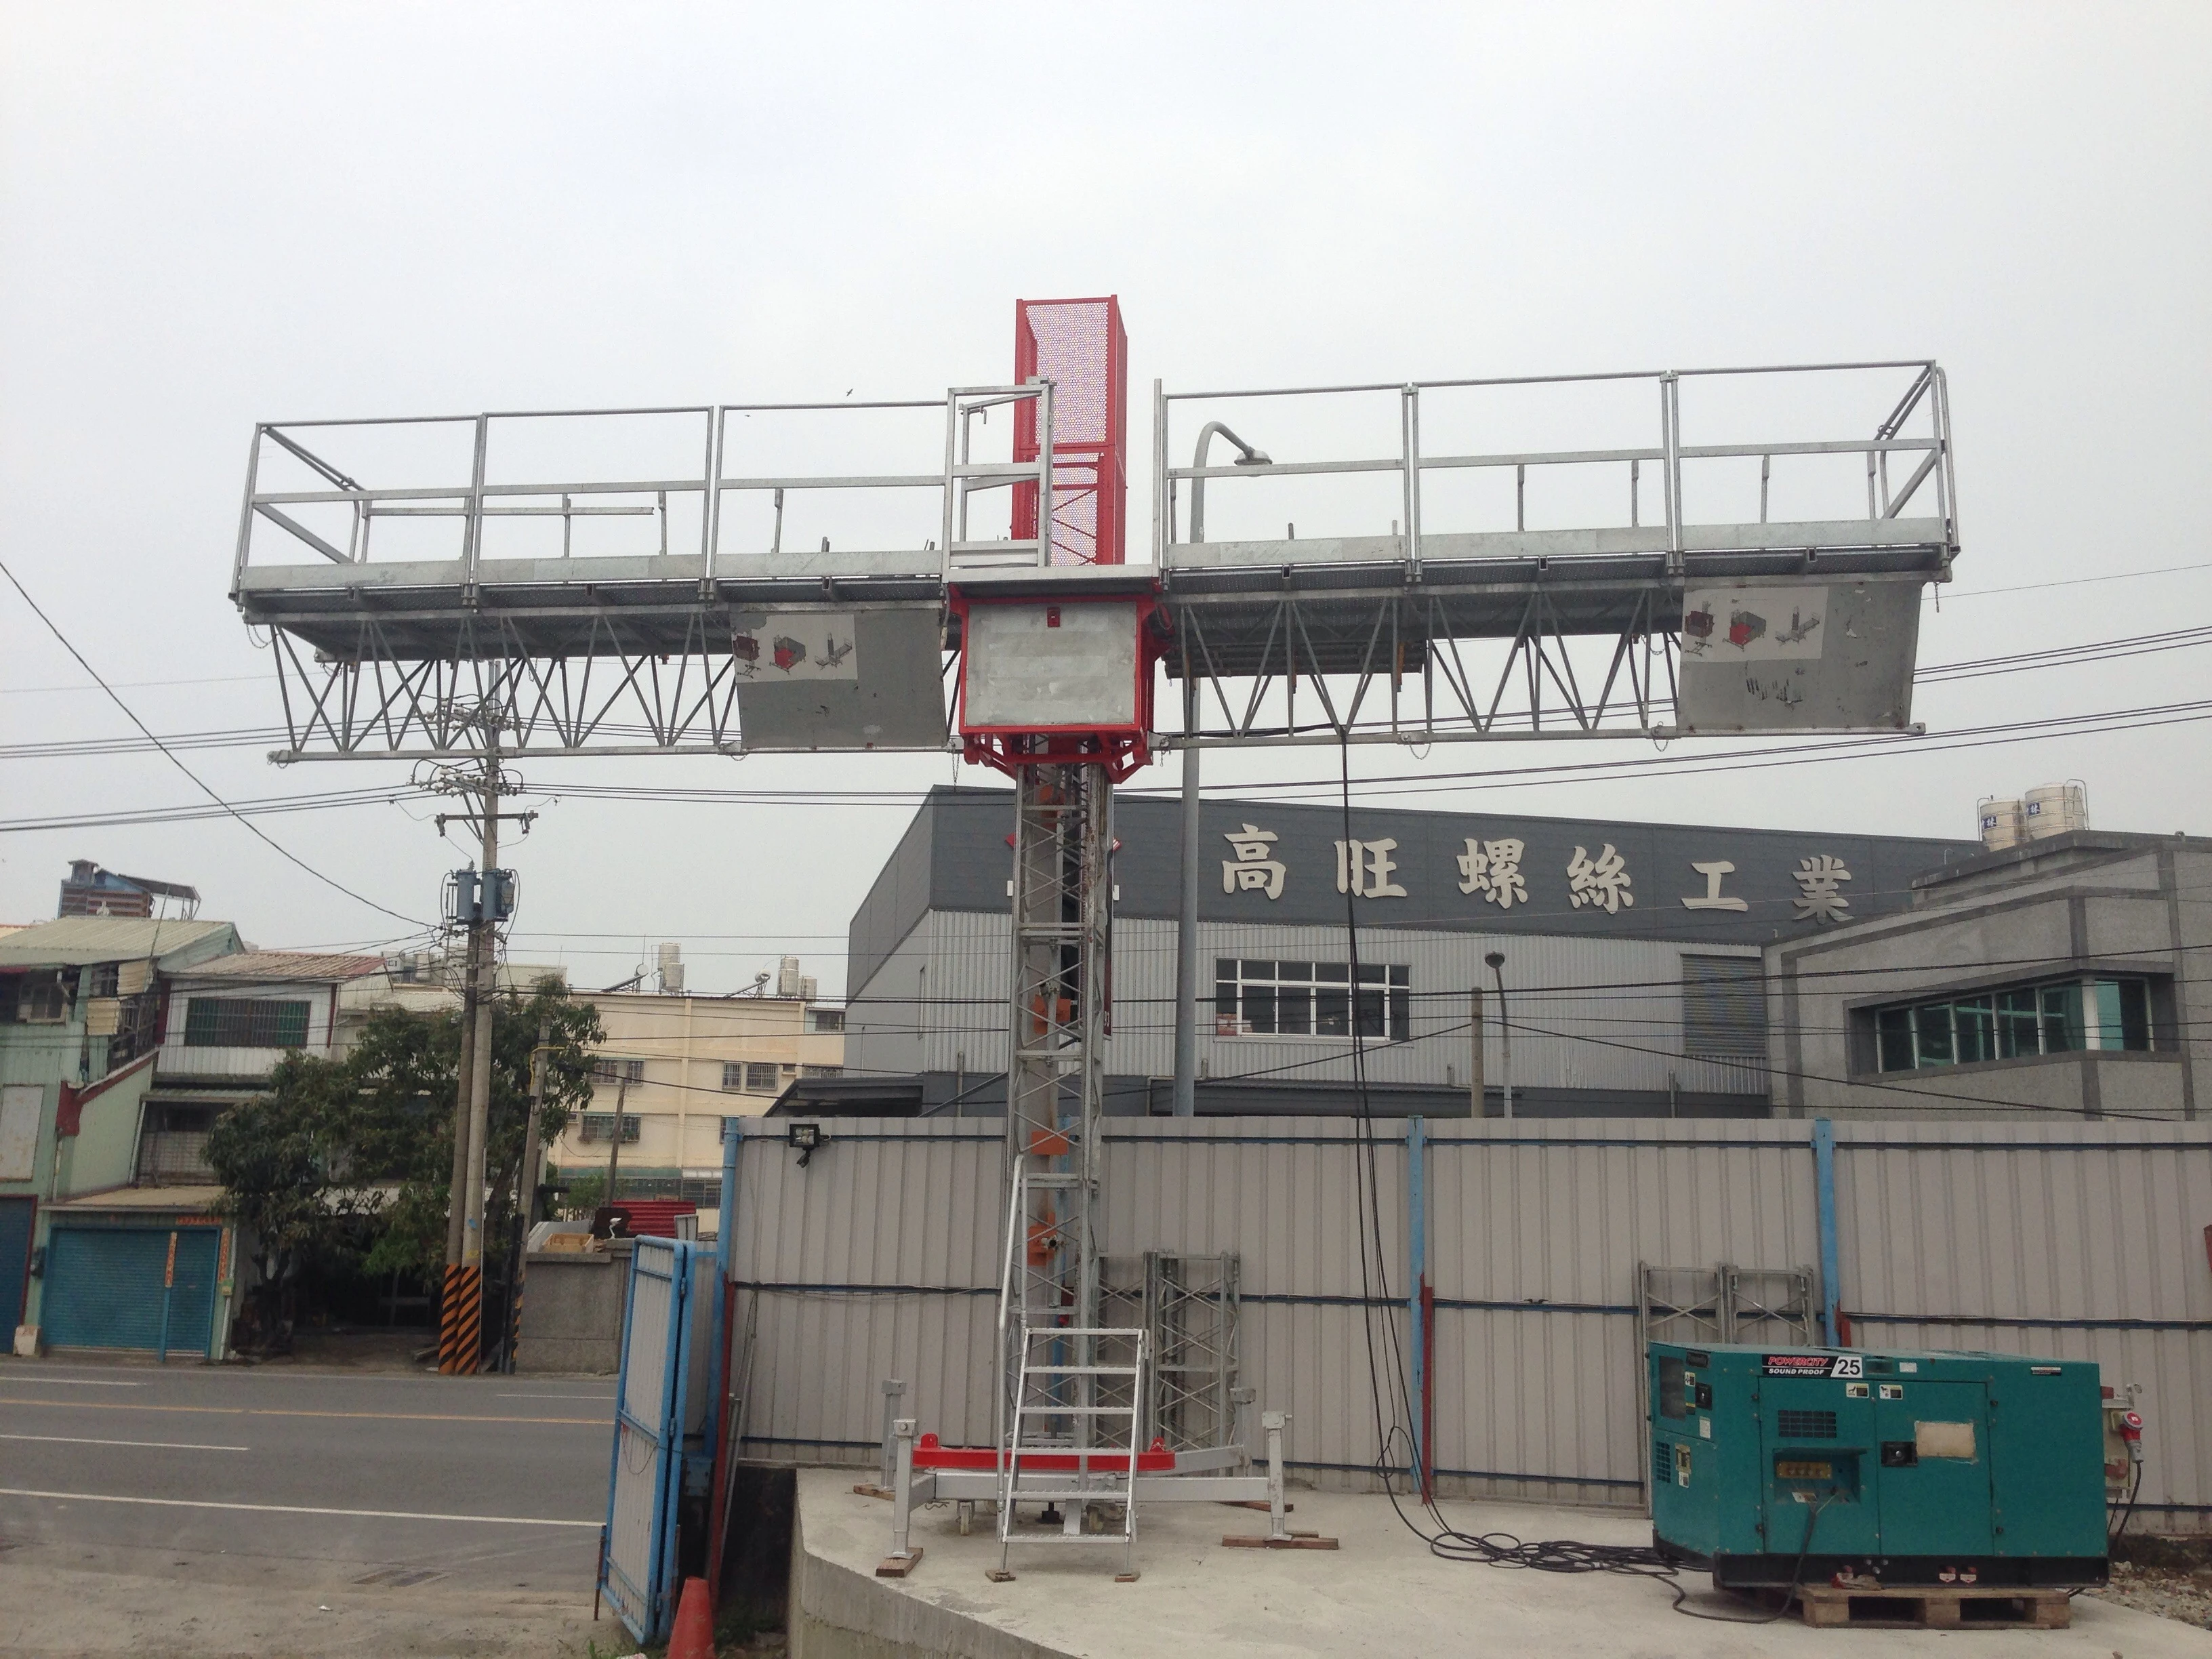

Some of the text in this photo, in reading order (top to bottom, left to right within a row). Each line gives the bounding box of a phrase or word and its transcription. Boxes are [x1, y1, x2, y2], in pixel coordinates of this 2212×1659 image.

[1222, 823, 1856, 924] 高旺螺絲工業
[1767, 1356, 1829, 1366] POWERCITY
[1837, 1359, 1861, 1375] 25
